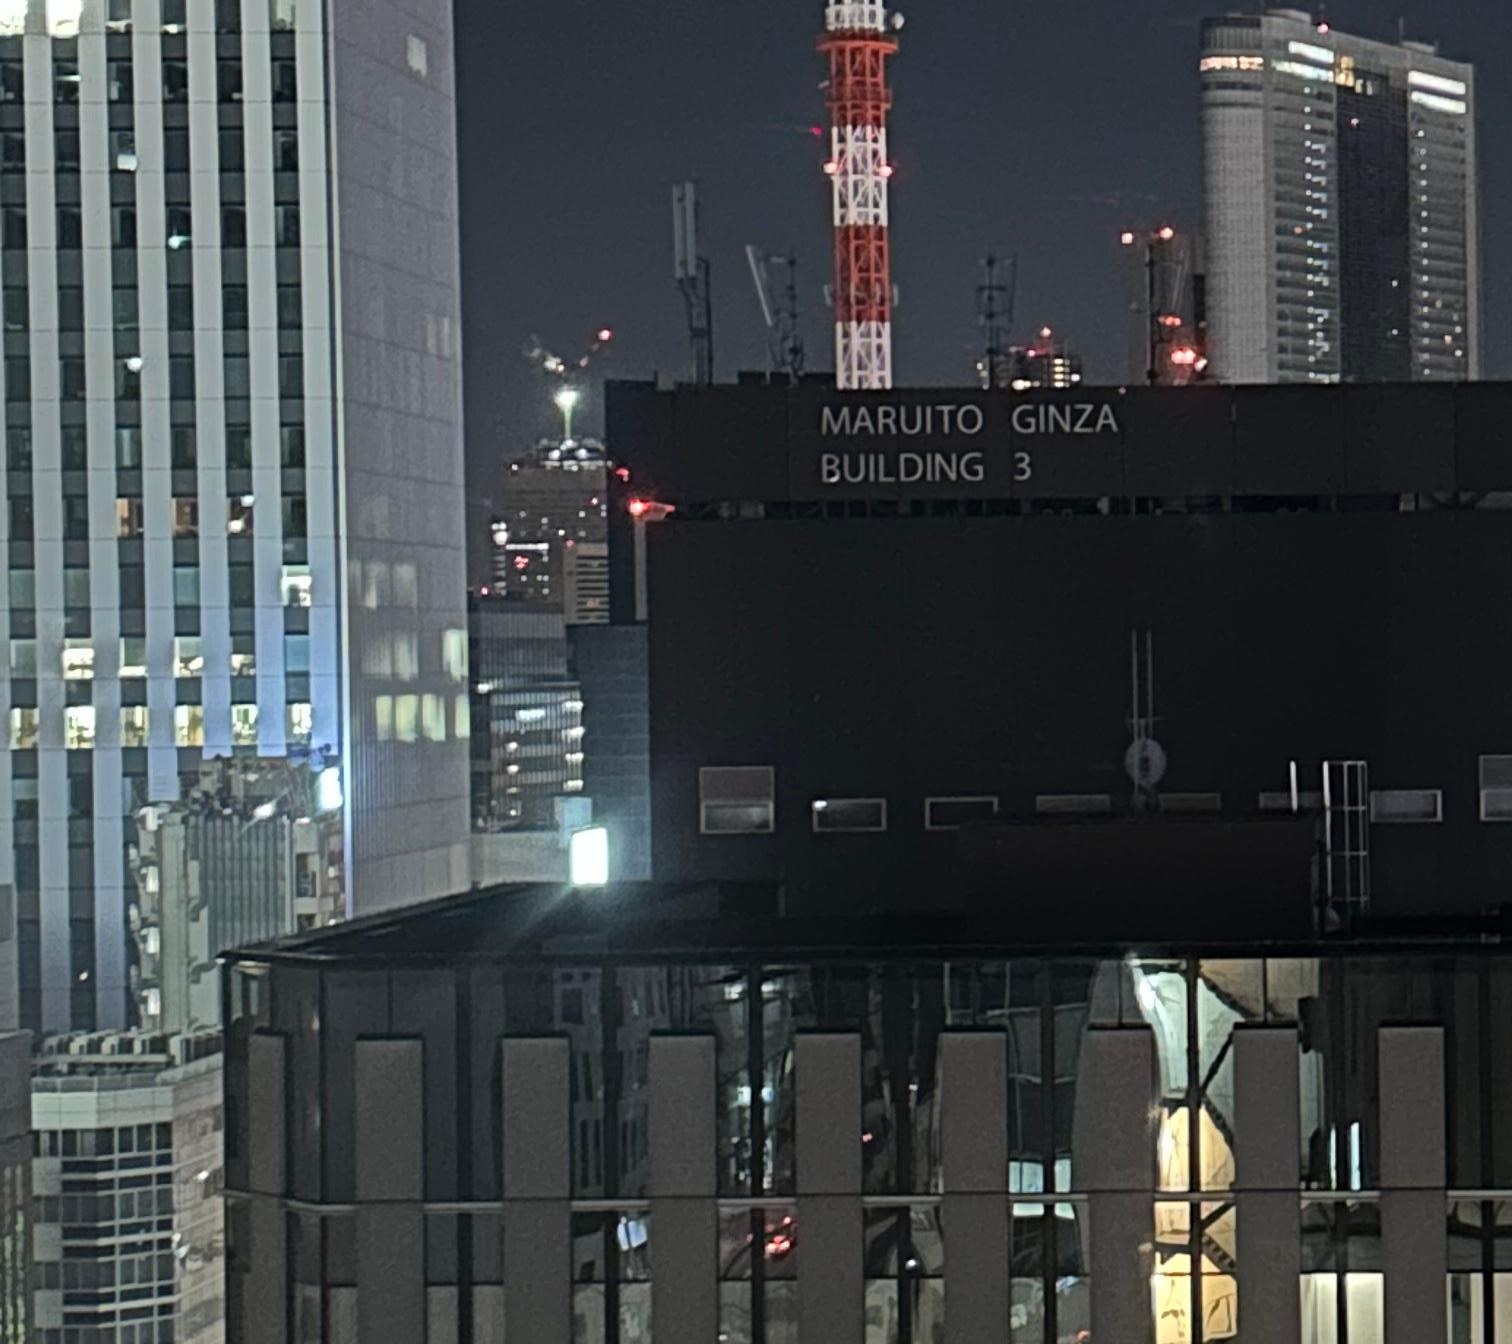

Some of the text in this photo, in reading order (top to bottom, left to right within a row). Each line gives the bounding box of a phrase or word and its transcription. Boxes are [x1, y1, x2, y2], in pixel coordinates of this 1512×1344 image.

[820, 403, 1119, 436] MARUITO GINZA
[820, 451, 1033, 483] BUILDING 3
